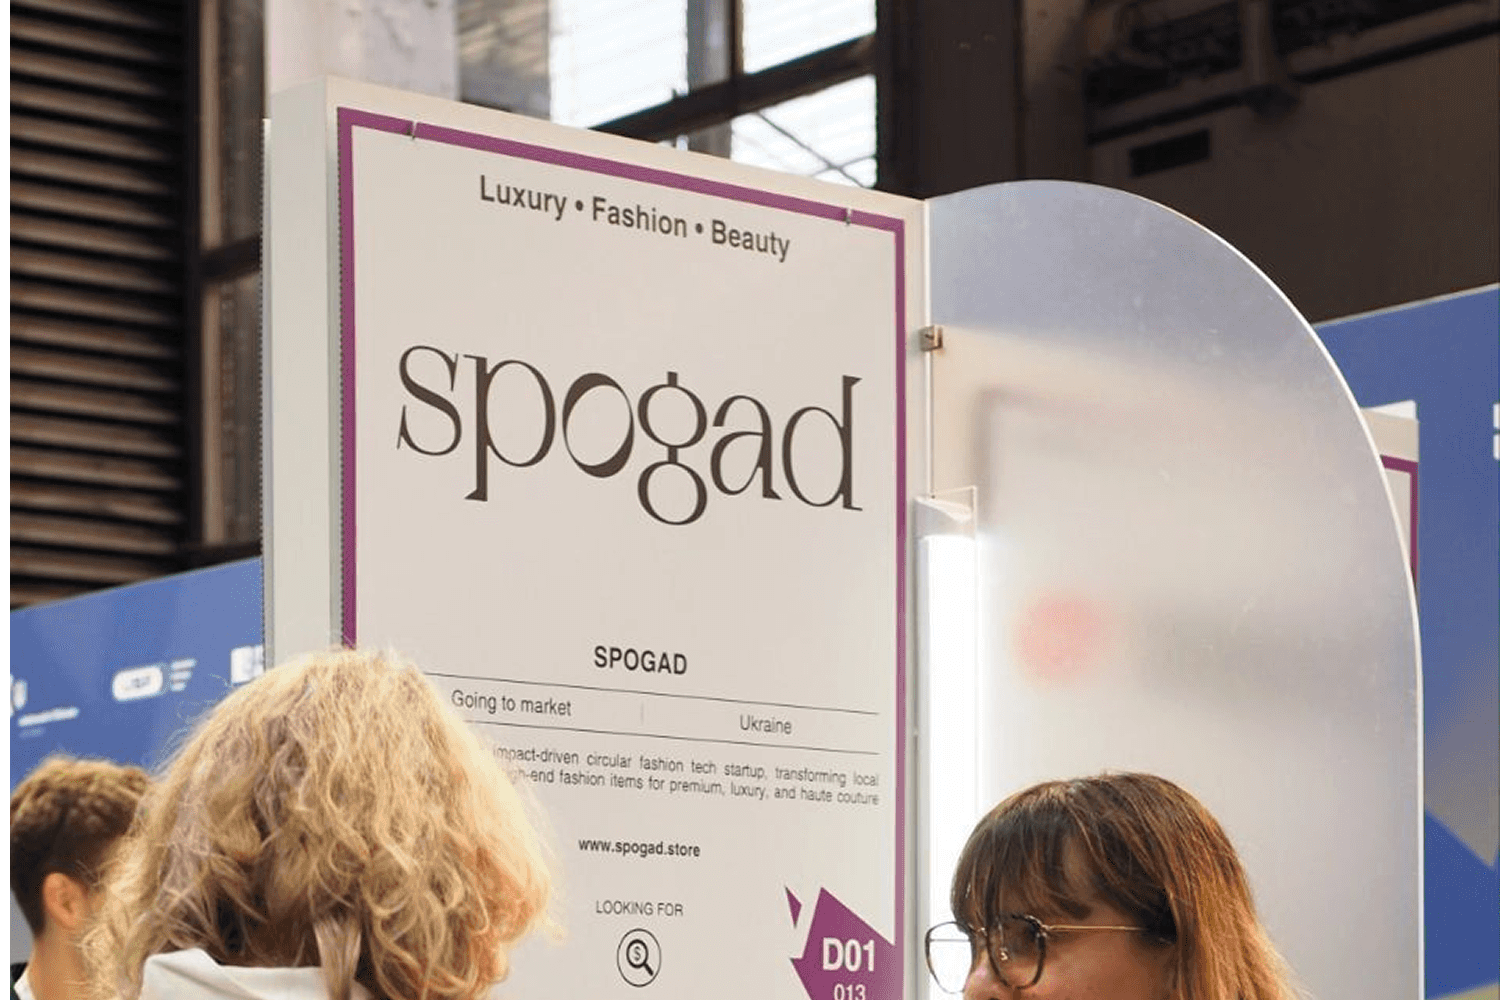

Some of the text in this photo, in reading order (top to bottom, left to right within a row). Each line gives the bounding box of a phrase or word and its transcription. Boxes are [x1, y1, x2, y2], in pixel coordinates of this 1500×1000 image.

[480, 174, 791, 263] Luxury Fashion Beauty
[396, 345, 863, 526] spogad
[594, 645, 688, 675] SPOGAD
[451, 689, 572, 717] Going to market
[740, 714, 792, 735] Ukraine
[587, 752, 632, 768] circular
[640, 755, 684, 773] fashion
[691, 759, 717, 775] tech
[724, 763, 768, 780] startup,
[775, 767, 847, 788] transforming
[853, 771, 880, 787] local
[559, 770, 605, 787] fashion
[610, 773, 644, 790] items
[648, 776, 665, 791] for
[669, 779, 725, 796] premium,
[731, 782, 769, 800] luxury,
[774, 786, 796, 800] and
[801, 788, 833, 803] haute
[837, 791, 880, 806] couture
[578, 839, 701, 858] www.spogad.store
[595, 900, 684, 917] LOOKING FOR
[822, 937, 875, 972] D01
